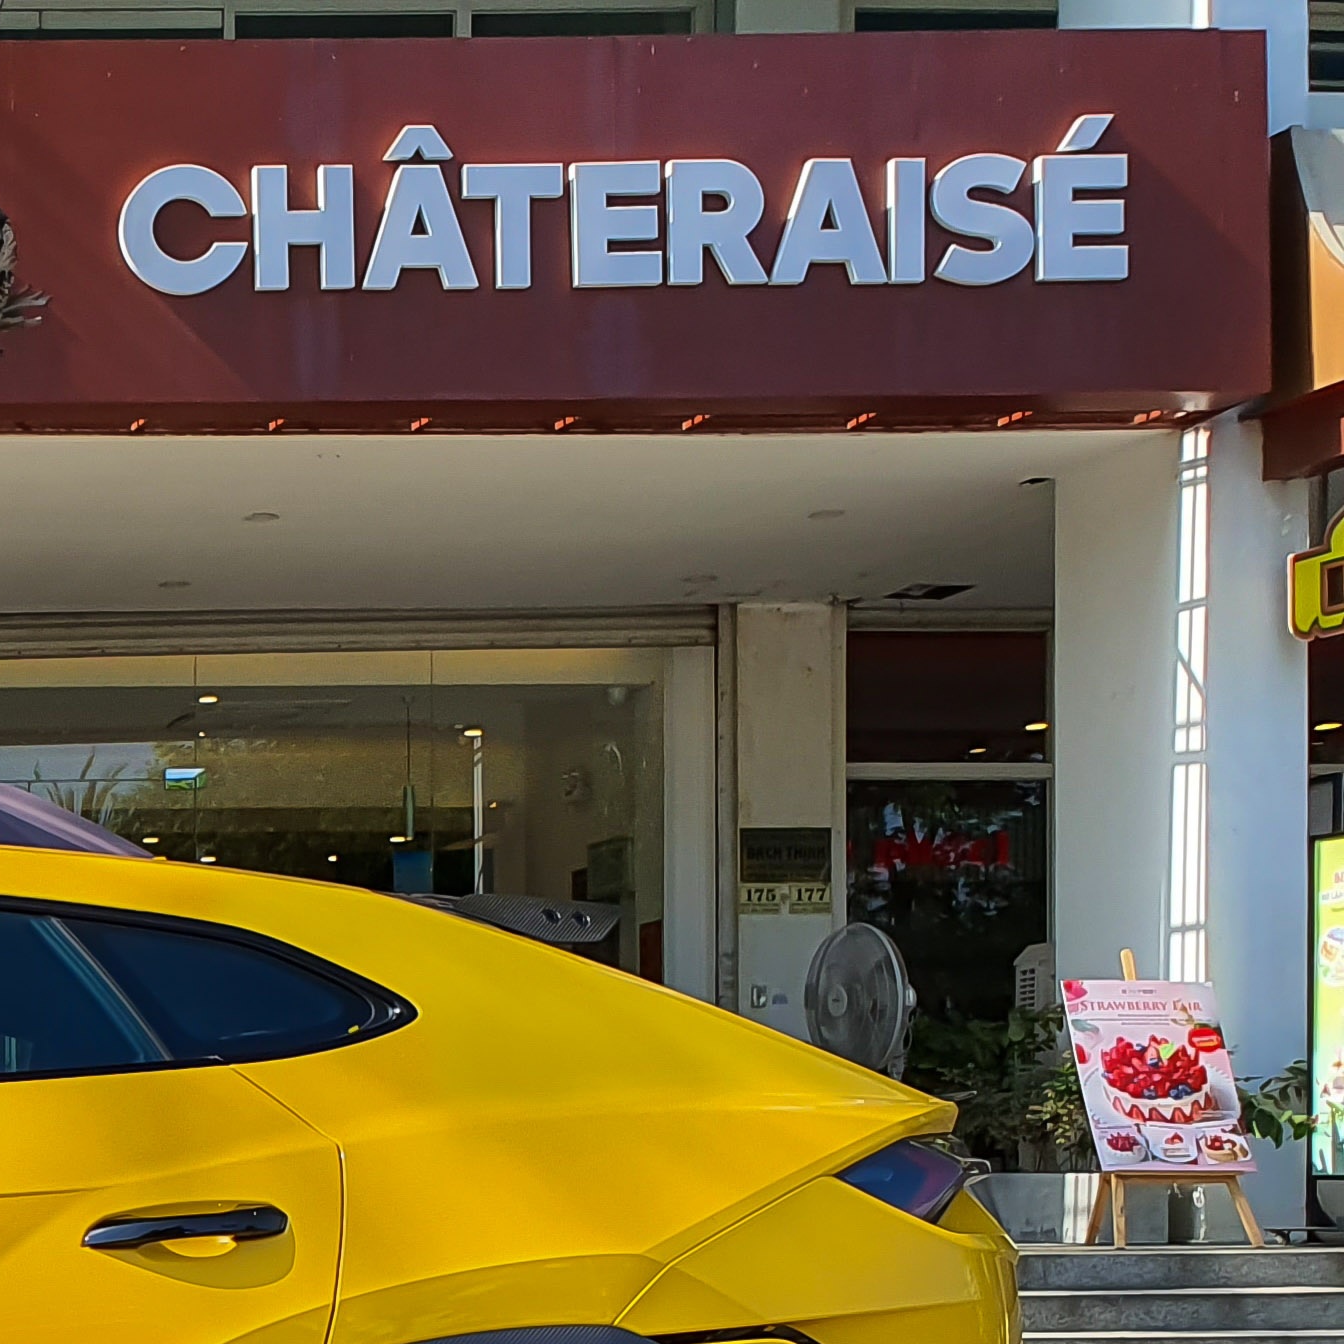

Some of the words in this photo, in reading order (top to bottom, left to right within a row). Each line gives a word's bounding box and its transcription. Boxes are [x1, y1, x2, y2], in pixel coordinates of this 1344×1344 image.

[118, 114, 1130, 294] CHÂTERAISÉ
[746, 887, 777, 902] 175
[796, 887, 827, 902] 177
